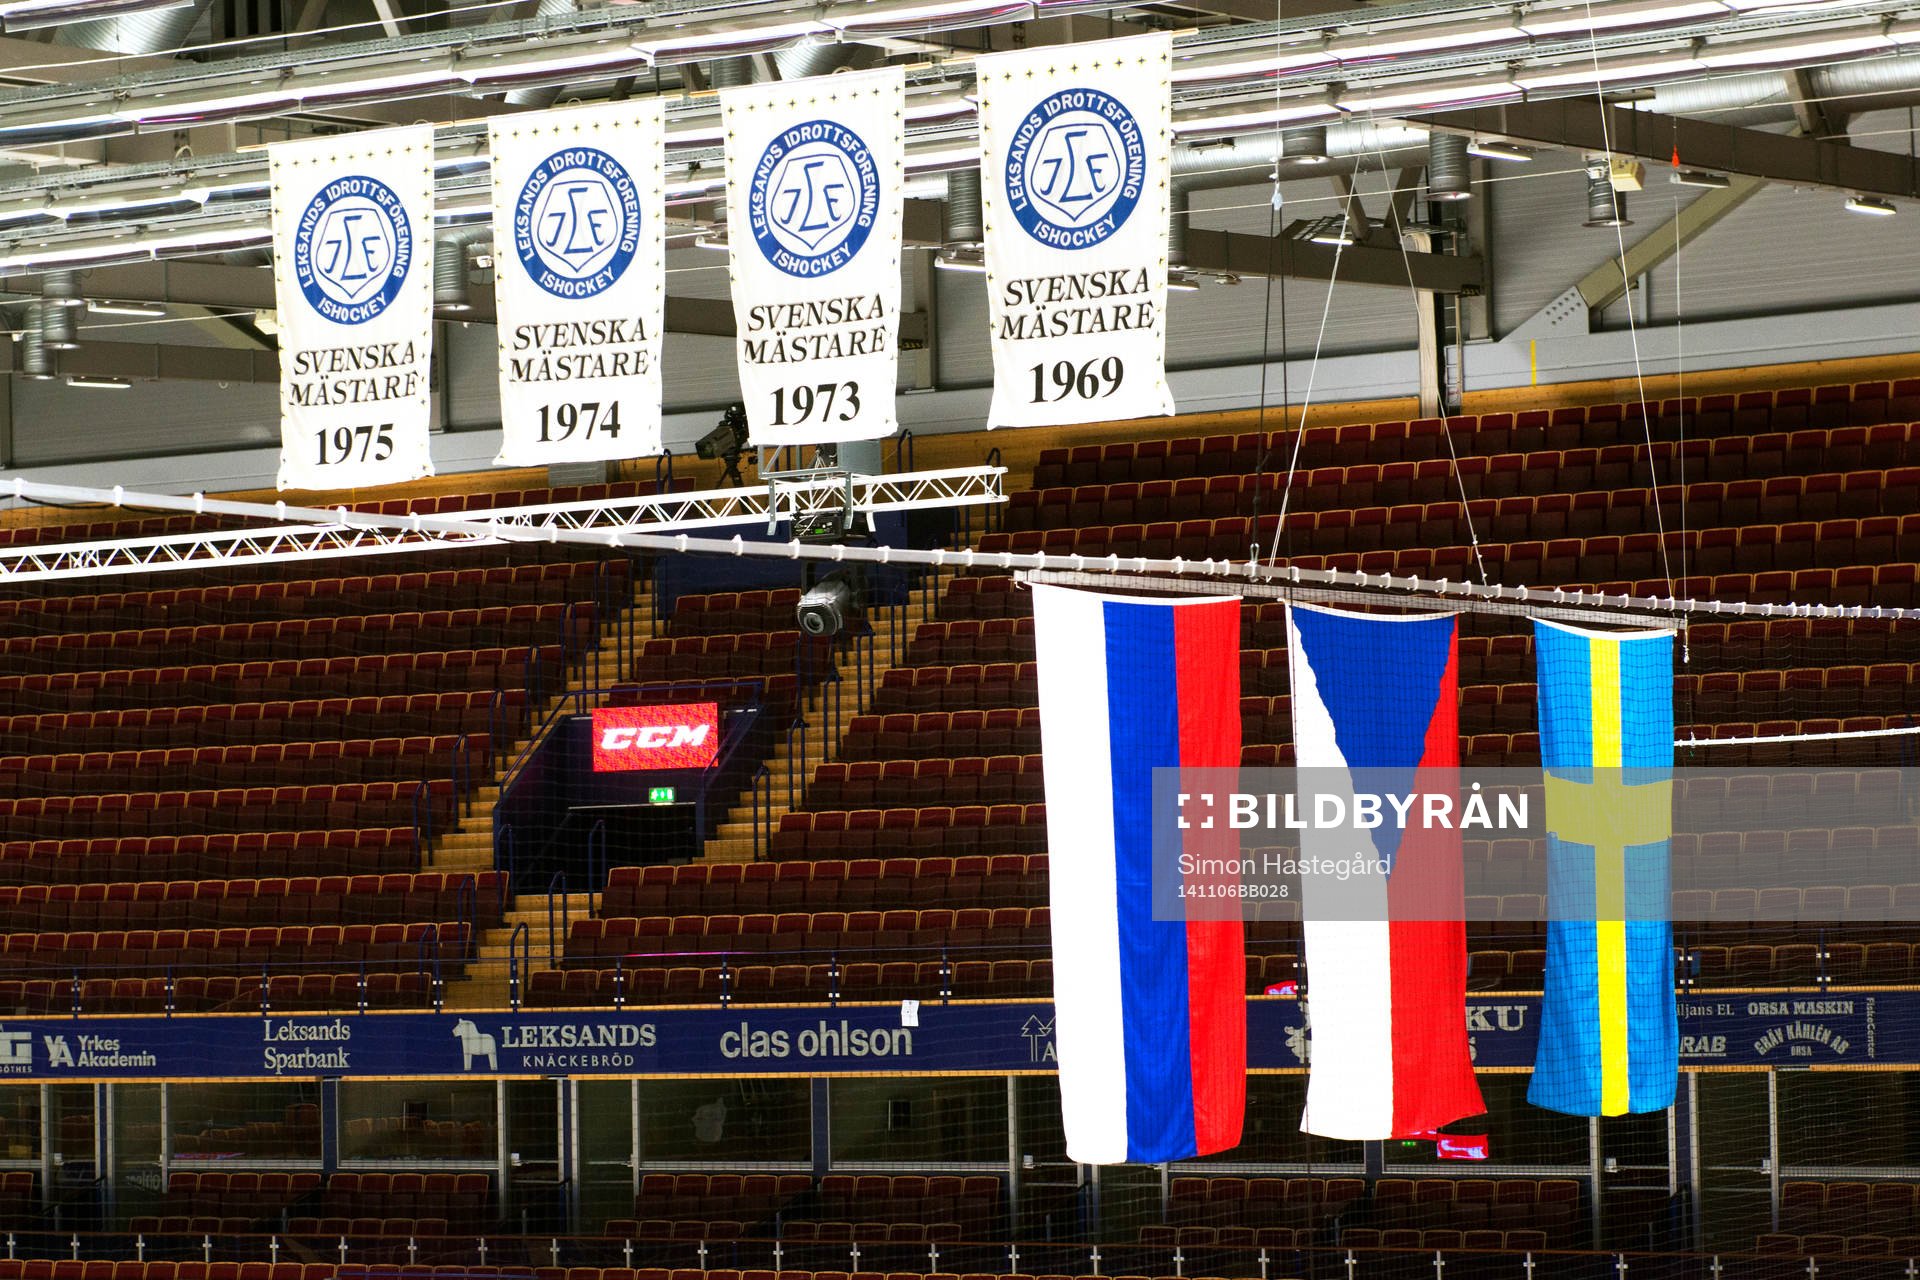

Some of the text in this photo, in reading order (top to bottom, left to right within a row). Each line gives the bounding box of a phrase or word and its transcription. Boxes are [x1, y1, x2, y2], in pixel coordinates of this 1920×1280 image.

[1009, 113, 1042, 212] LEKSANDS
[752, 144, 783, 240] LEKSANDS
[517, 169, 548, 261] LEKSANDS
[1033, 214, 1116, 246] ISHOCKEY
[297, 198, 326, 288] LEKSANDS
[772, 242, 851, 275] ISHOCKEY
[539, 266, 615, 296] ISHOCKEY
[1004, 266, 1150, 307] SVENSKA
[317, 291, 388, 322] ISHOCKEY
[747, 293, 884, 332] SVENSKA
[999, 300, 1155, 340] MÄSTARE
[513, 316, 647, 351] SVENSKA
[743, 324, 887, 364] MÄSTARE
[294, 340, 415, 376] SVENSKA
[509, 349, 649, 383] MÄSTARE
[288, 370, 419, 407] MÄSTARE
[1028, 356, 1124, 403] 1969
[769, 380, 861, 426] 1973
[536, 400, 621, 443] 1974
[314, 423, 394, 466] 1975
[600, 724, 710, 749] CCM
[1747, 1000, 1855, 1016] ORSA MASKIN
[77, 1035, 121, 1051] Yrkes
[263, 1018, 351, 1041] Leksands
[501, 1024, 657, 1048] LEKSANDS
[719, 1020, 913, 1059] clas ohlson
[1830, 1035, 1850, 1055] AB
[77, 1051, 156, 1067] Akademin
[263, 1046, 351, 1075] Sparbank
[523, 1052, 634, 1067] KNÄCKEBRÖD
